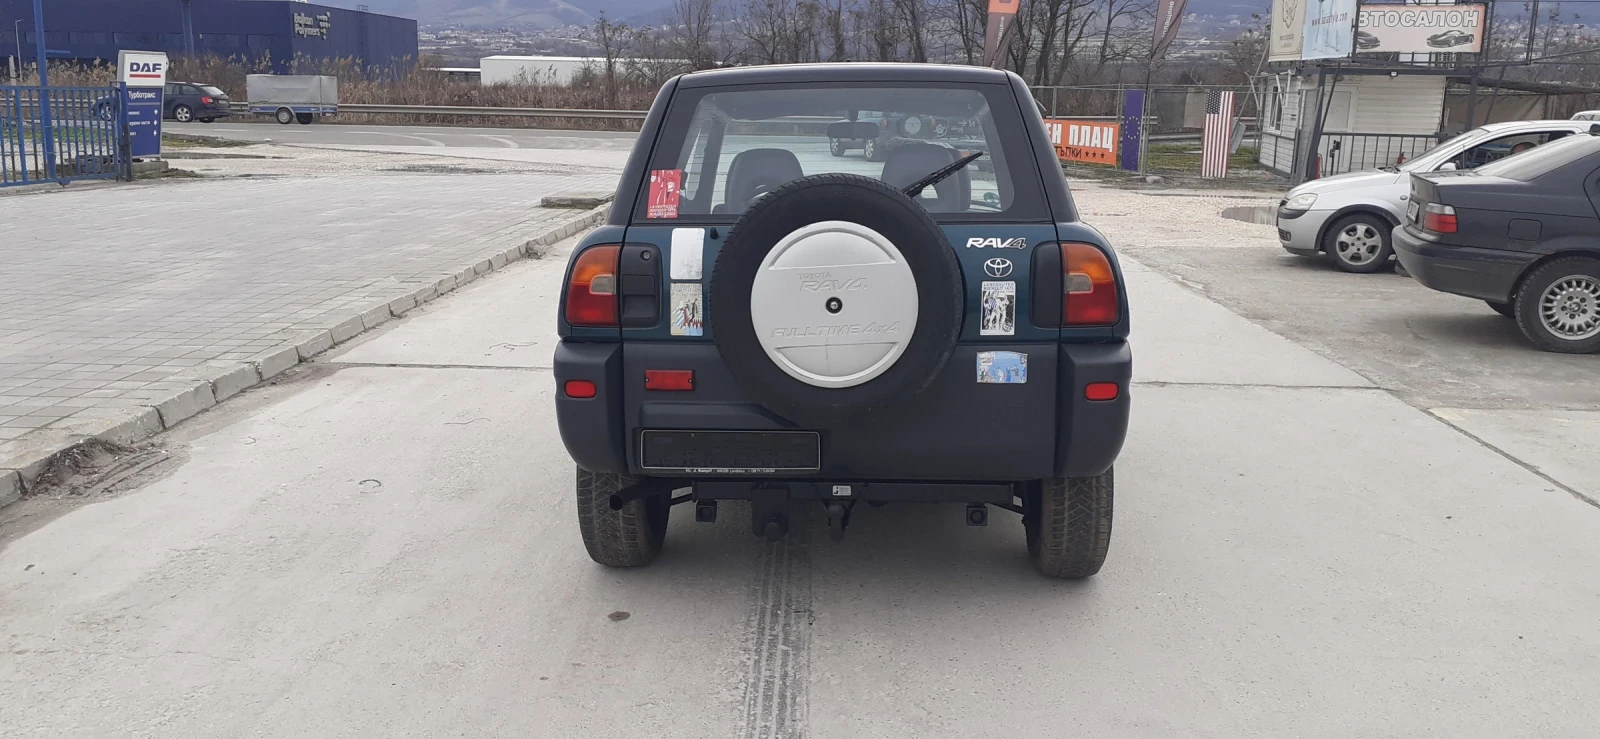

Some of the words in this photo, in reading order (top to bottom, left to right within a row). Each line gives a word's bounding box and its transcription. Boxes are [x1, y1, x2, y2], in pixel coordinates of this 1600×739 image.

[293, 12, 314, 26] Balkan
[294, 23, 321, 38] Polymers
[129, 62, 162, 73] DAF
[128, 91, 156, 100] Турботракс
[1069, 124, 1114, 153] ПЛАЦ
[966, 237, 1027, 249] RAV4
[800, 277, 868, 293] RAV4
